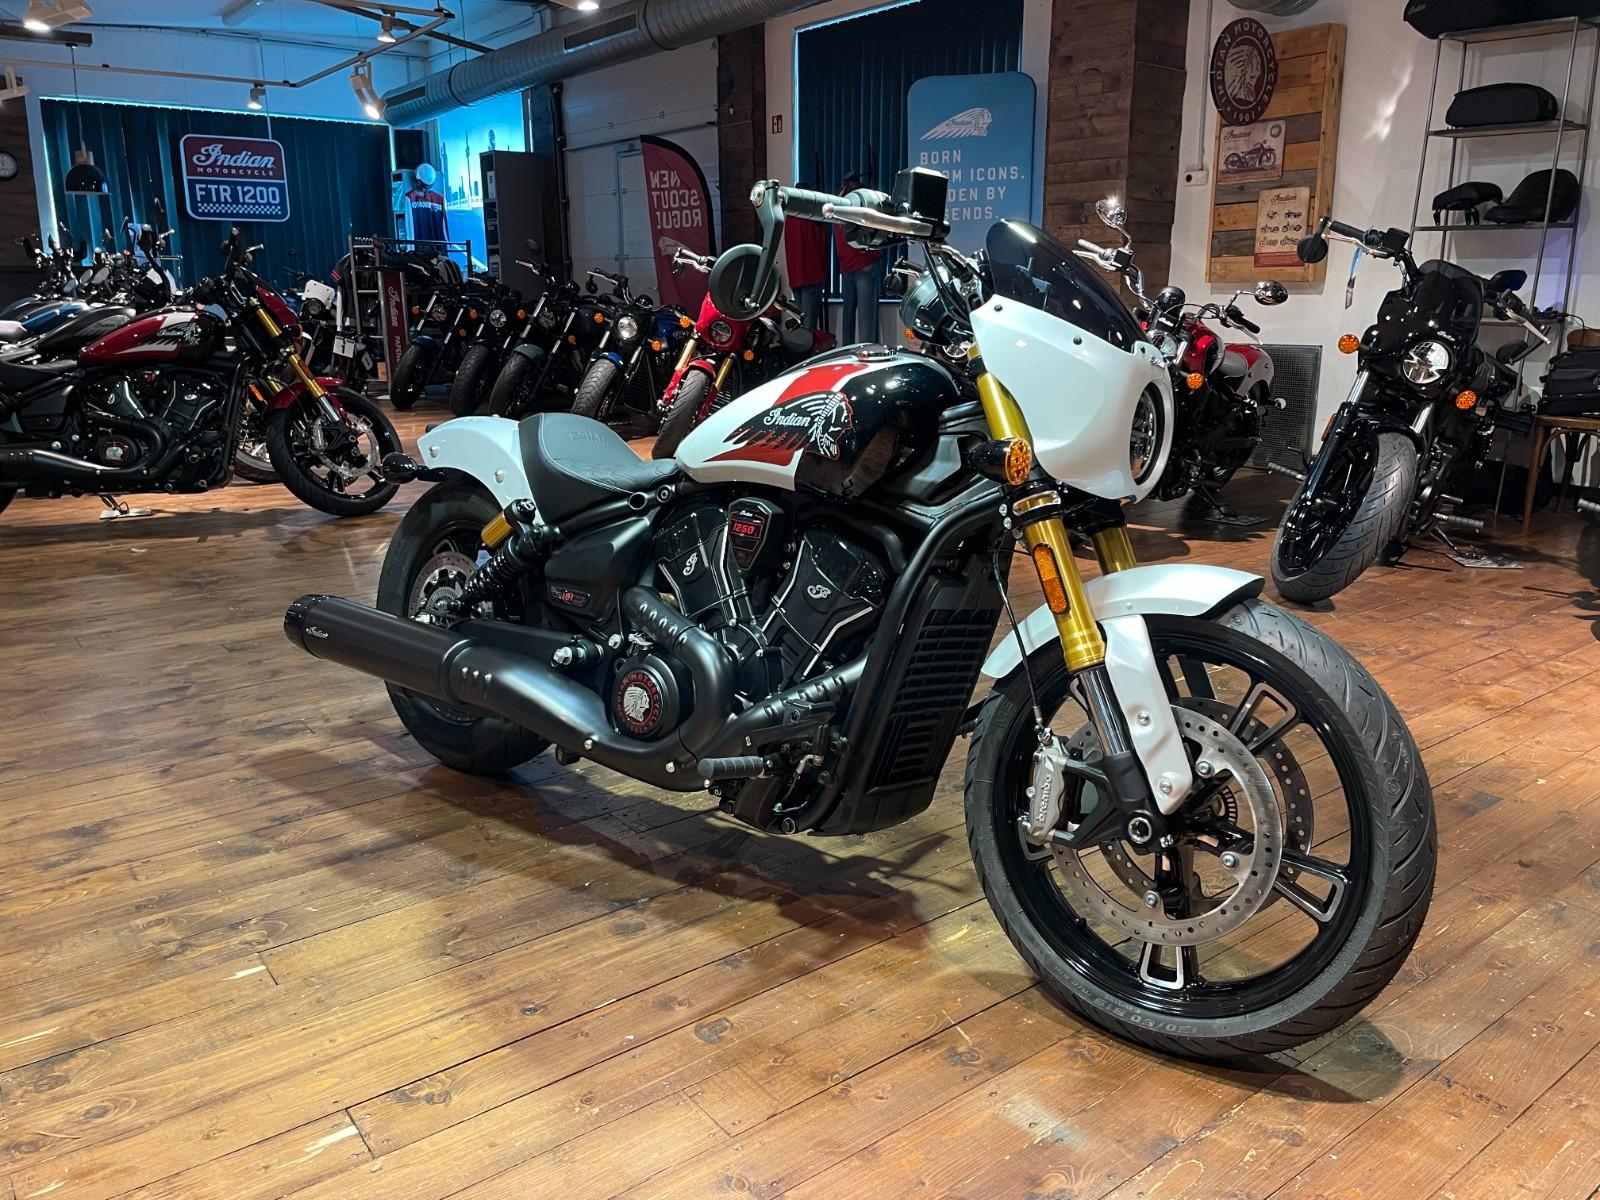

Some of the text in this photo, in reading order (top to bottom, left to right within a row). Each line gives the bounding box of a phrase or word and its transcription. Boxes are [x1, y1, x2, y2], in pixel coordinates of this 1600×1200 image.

[1233, 111, 1255, 122] 1901
[192, 143, 275, 169] Indian
[920, 149, 961, 165] BORN
[197, 167, 274, 176] MOTORCYCLE
[970, 166, 1025, 182] ICONS.
[236, 186, 280, 204] 1200
[986, 186, 1007, 200] BY
[387, 286, 401, 327] Indian
[763, 407, 811, 427] Indian
[732, 522, 755, 534] 1250
[1035, 774, 1052, 824] brembo
